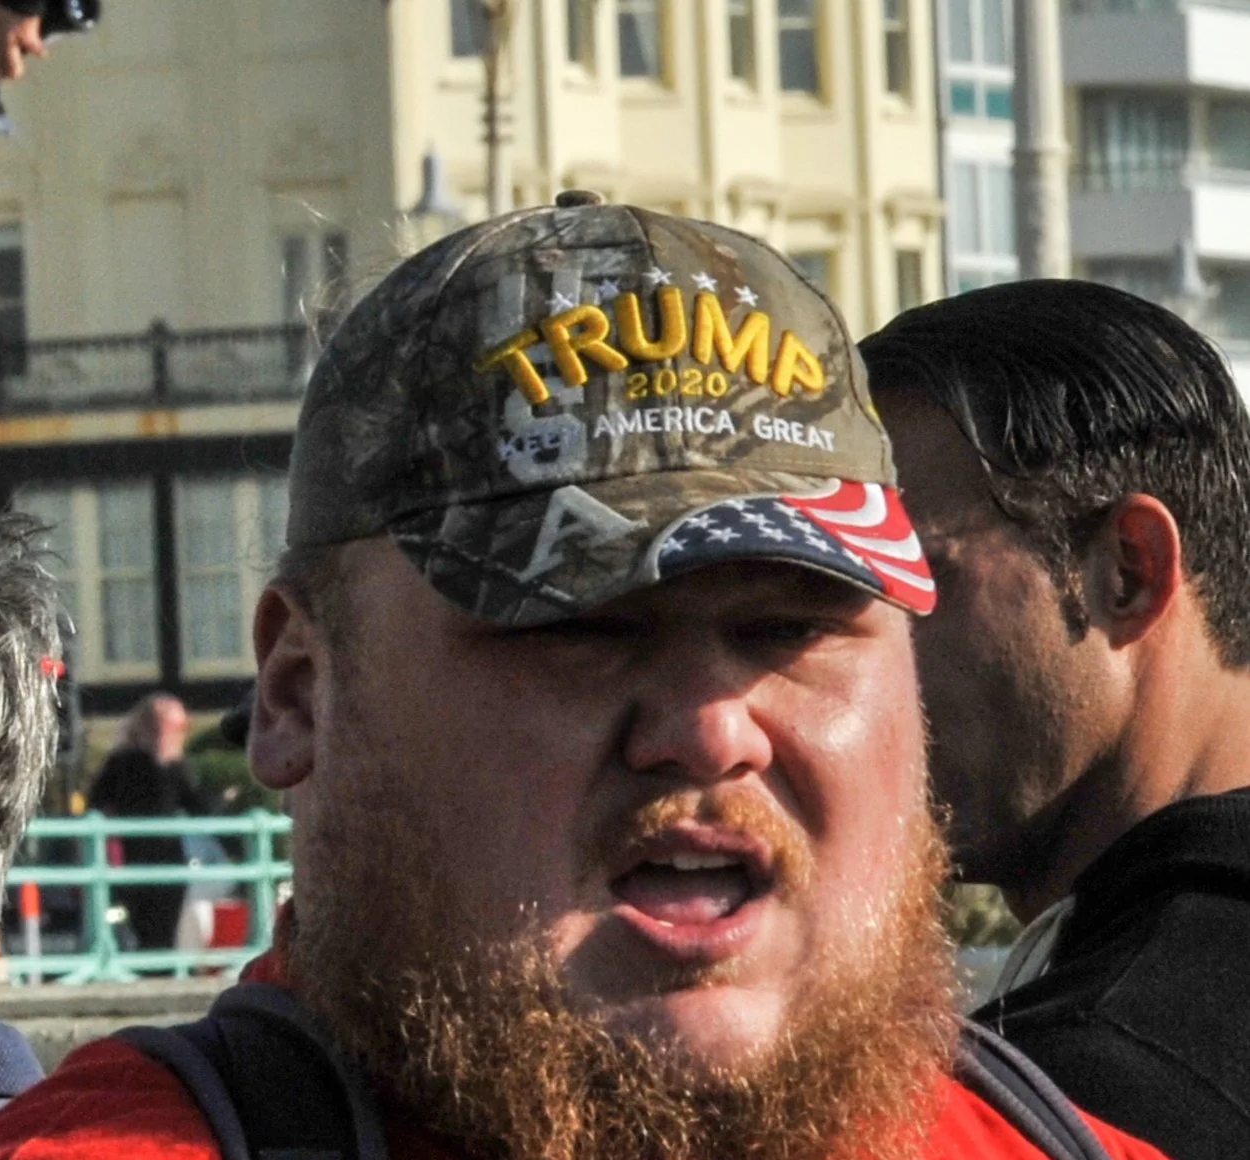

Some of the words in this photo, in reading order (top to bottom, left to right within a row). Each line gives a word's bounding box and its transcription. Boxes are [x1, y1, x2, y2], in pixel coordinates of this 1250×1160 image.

[475, 286, 824, 402] TRUMP
[627, 369, 728, 399] 2020
[593, 407, 736, 439] AMERICA
[754, 414, 835, 453] GREAT
